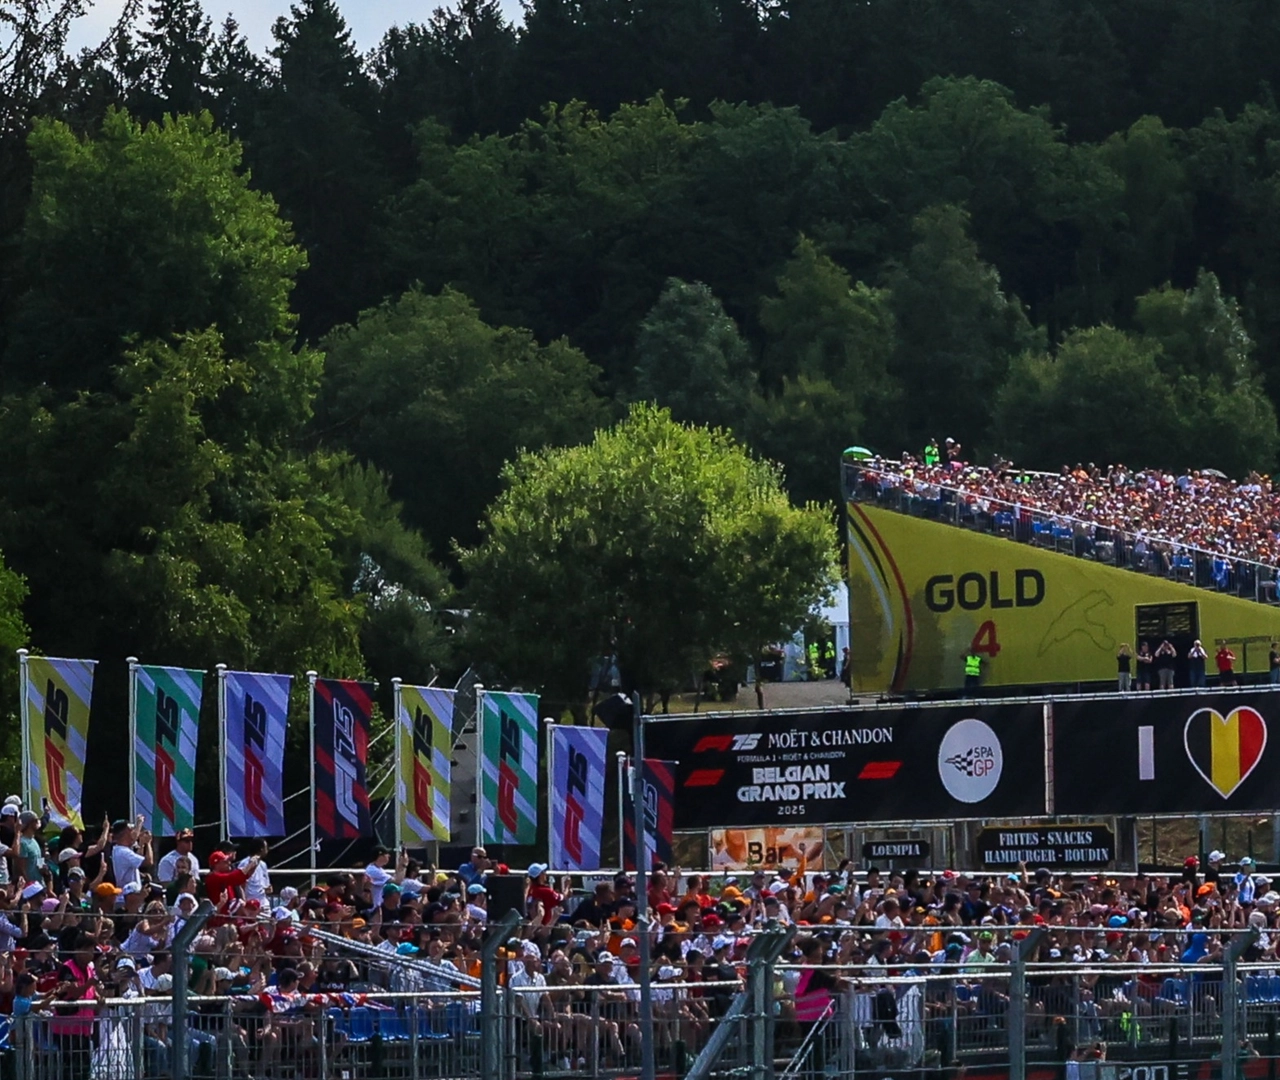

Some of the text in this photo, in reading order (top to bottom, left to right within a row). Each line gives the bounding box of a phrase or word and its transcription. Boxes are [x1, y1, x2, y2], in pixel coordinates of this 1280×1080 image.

[925, 569, 1046, 613] GOLD
[971, 620, 1000, 658] 4
[768, 729, 808, 749] MOËT
[811, 731, 820, 746] &
[822, 727, 893, 746] CHANDON
[737, 755, 770, 763] FORMULA
[810, 751, 846, 761] CHANDON
[974, 747, 993, 758] SPA
[1138, 725, 1154, 780] I
[753, 763, 830, 784] BELGIAN
[974, 759, 994, 776] GP
[737, 782, 846, 802] GRAND PRIX
[777, 805, 806, 815] 2025
[999, 833, 1039, 846] FRITES
[1047, 832, 1093, 845] SNACKS
[748, 842, 786, 864] Bar
[872, 844, 920, 857] LOEMPIA
[985, 850, 1056, 863] HAMBURGER
[1065, 848, 1109, 862] BOUDIN
